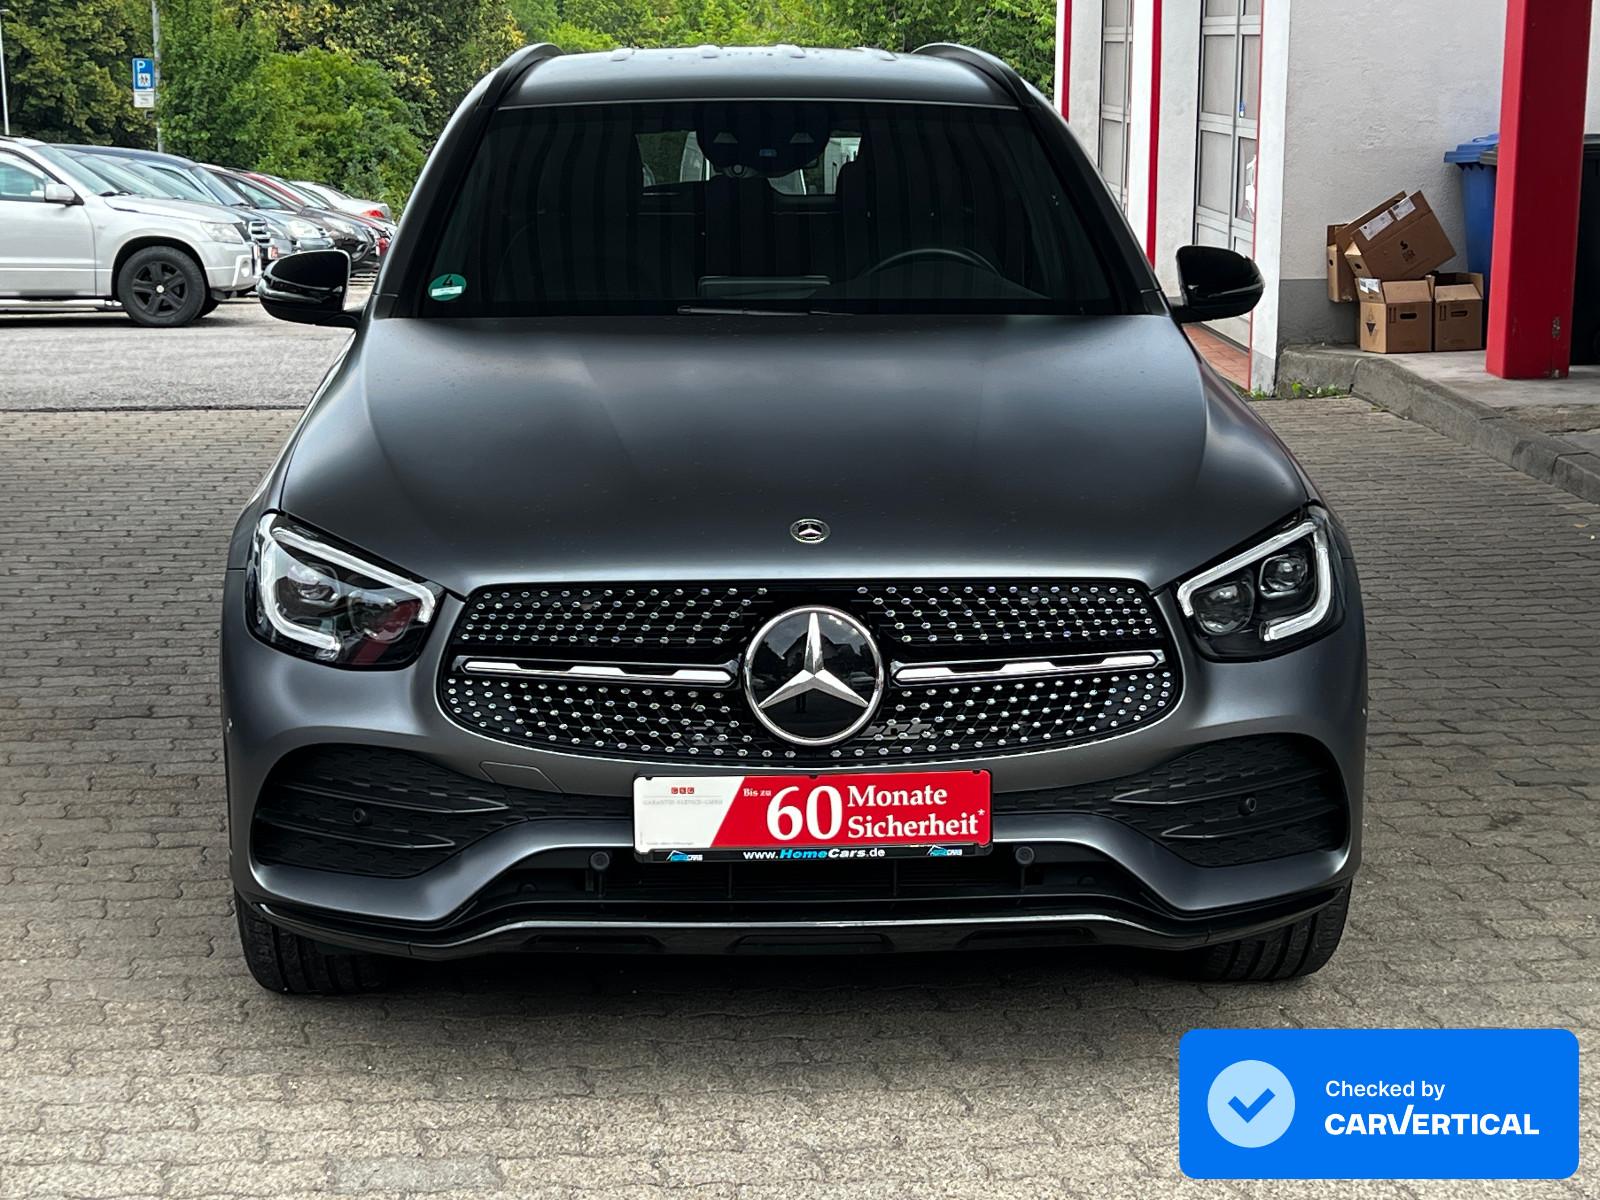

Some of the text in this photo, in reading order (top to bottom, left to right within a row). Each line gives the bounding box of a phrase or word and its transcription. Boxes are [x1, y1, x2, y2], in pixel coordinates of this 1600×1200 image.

[137, 60, 146, 73] P
[442, 274, 453, 287] 4
[847, 784, 948, 807] Monate
[743, 785, 843, 841] Bis zu 60
[742, 847, 886, 860] www.HomeCars.de
